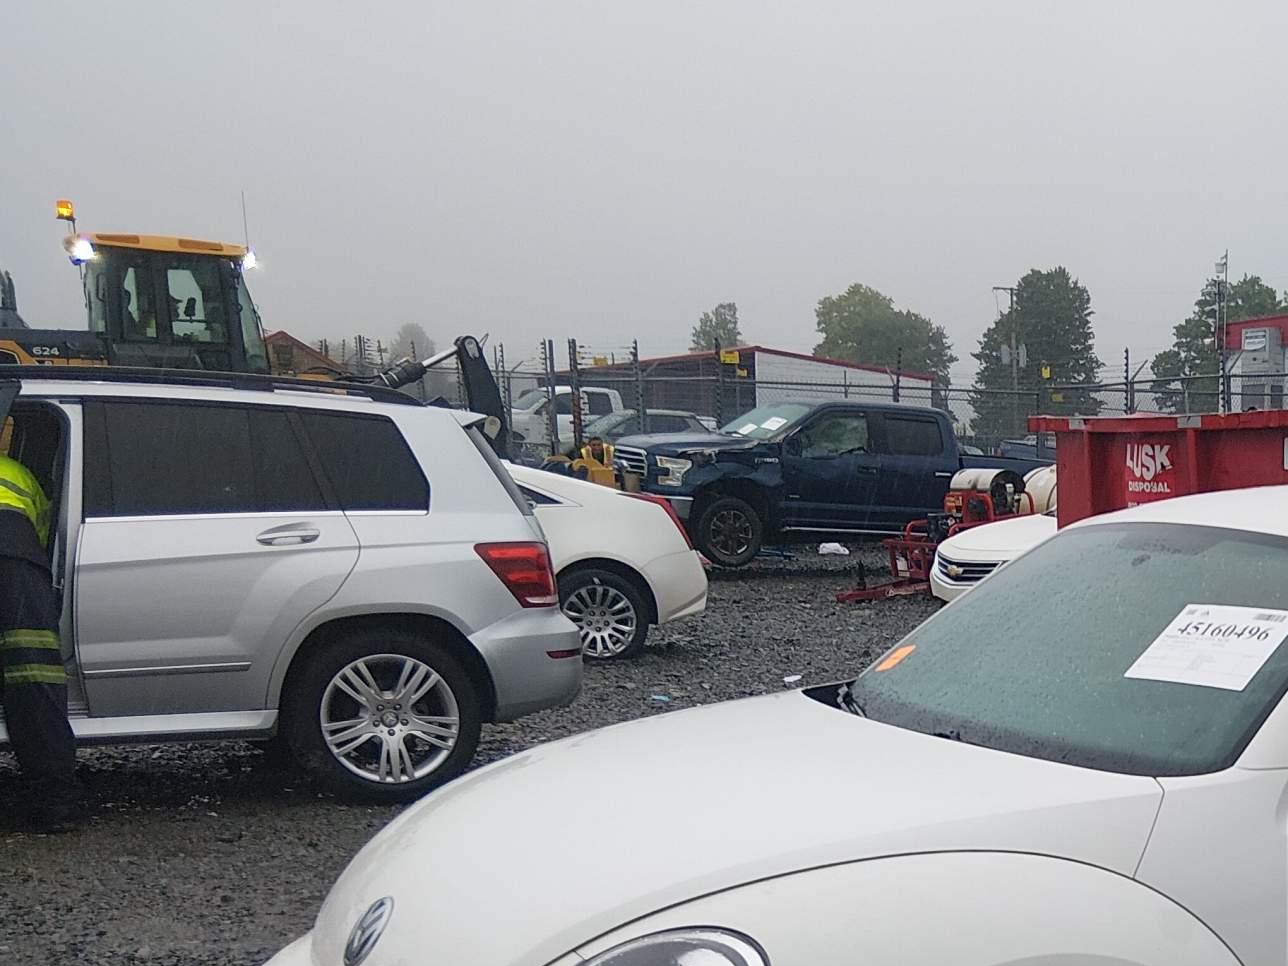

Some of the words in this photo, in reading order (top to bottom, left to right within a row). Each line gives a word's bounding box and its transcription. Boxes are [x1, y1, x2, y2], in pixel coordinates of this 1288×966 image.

[33, 347, 60, 355] 624
[1126, 443, 1173, 481] LUSK
[1177, 622, 1274, 641] 45160496
